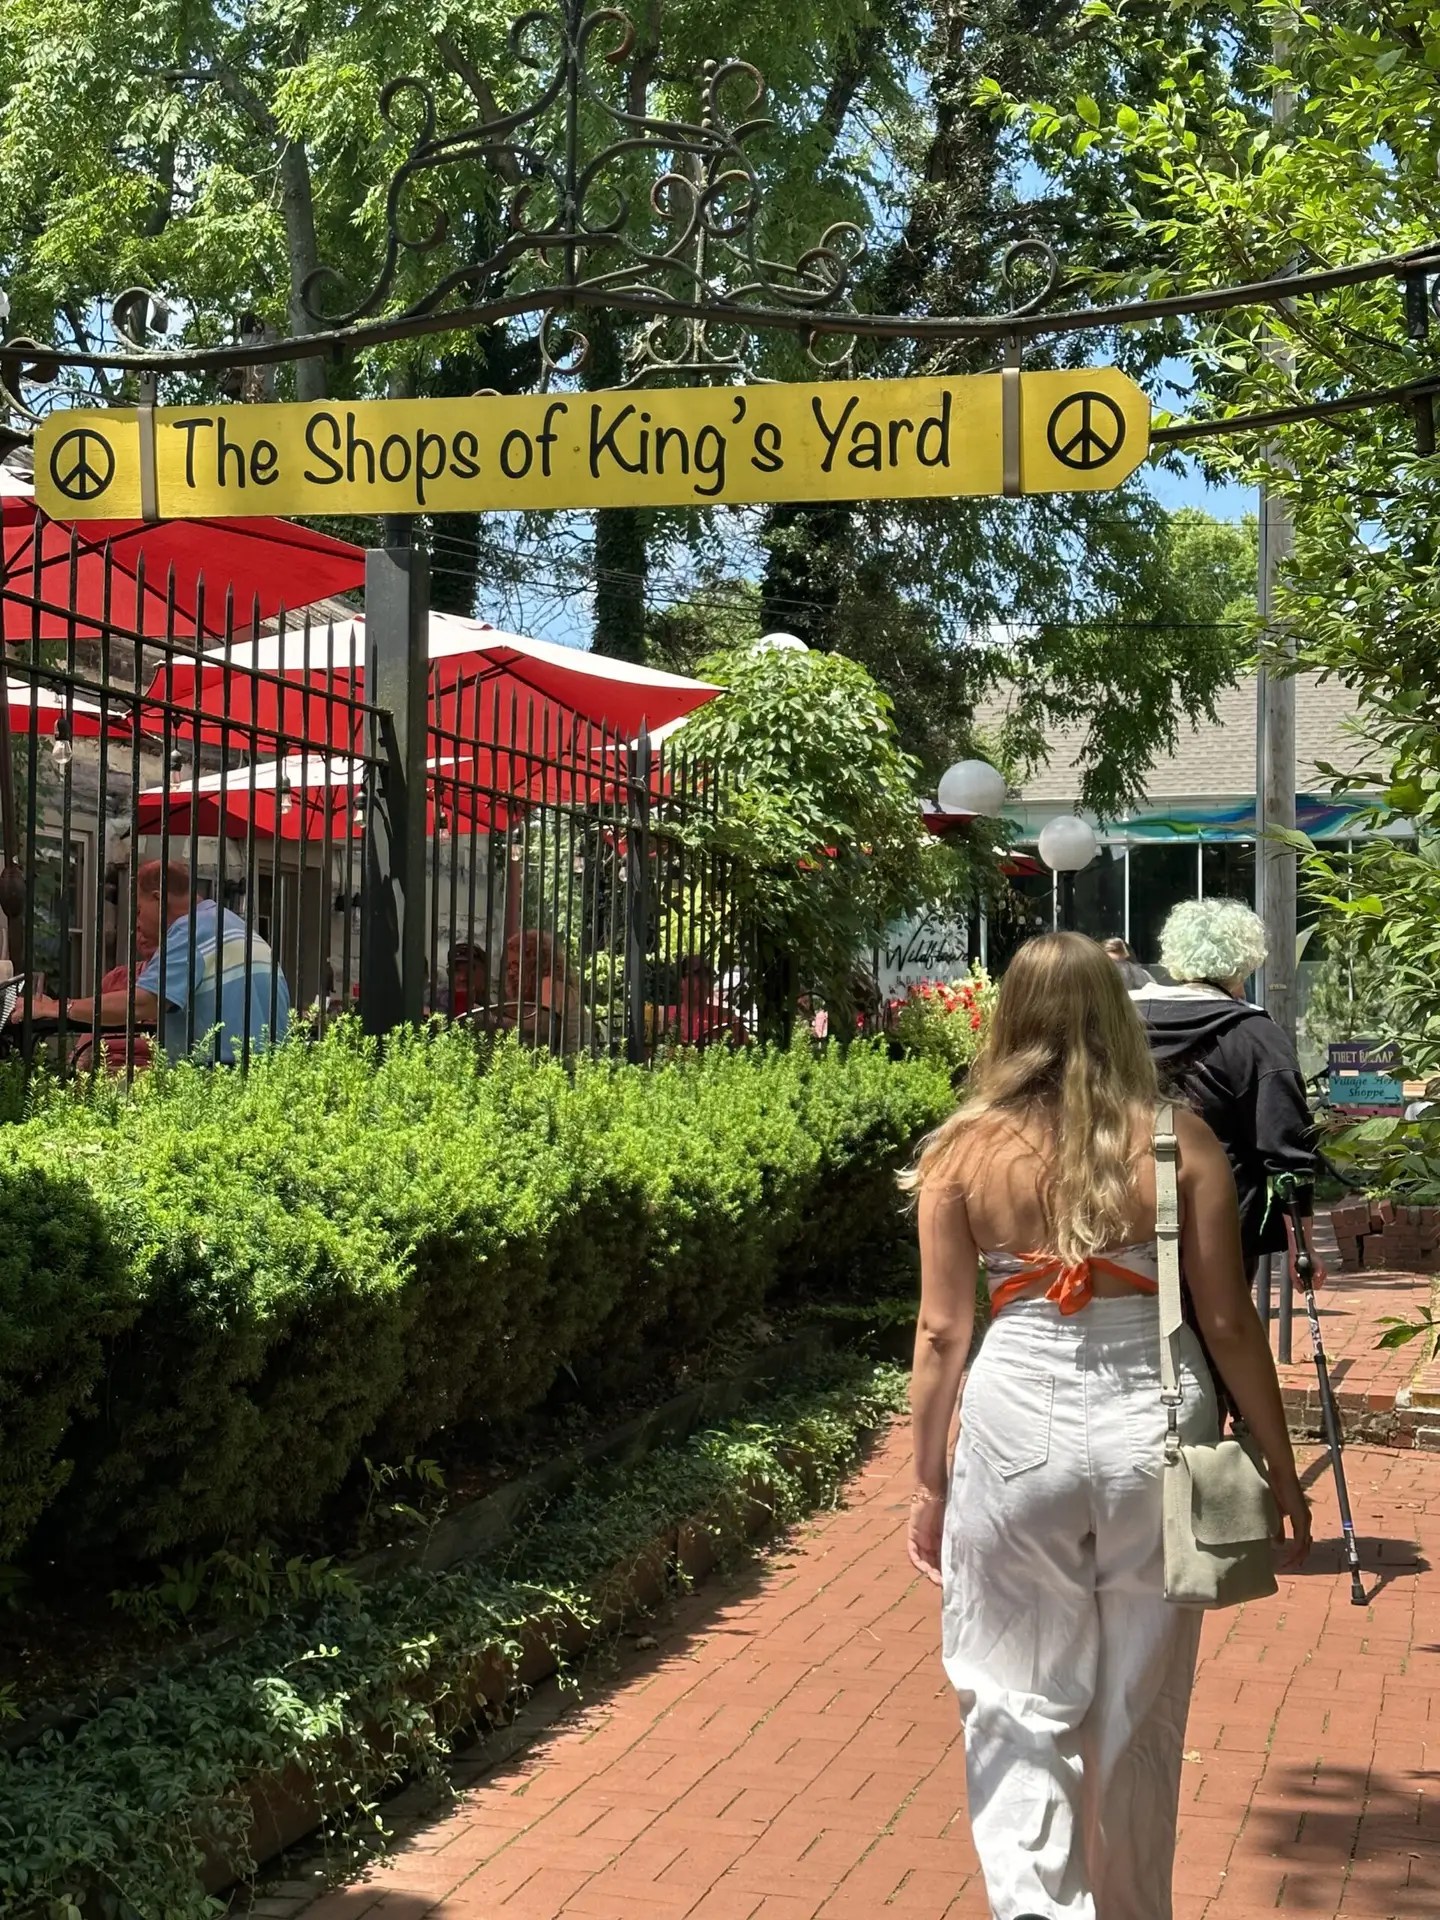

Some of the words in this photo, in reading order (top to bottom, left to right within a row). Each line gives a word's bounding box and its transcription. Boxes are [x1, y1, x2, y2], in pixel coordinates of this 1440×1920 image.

[172, 416, 280, 489] The
[303, 411, 482, 506] Shops
[499, 401, 569, 480] of
[589, 395, 785, 497] King's
[811, 390, 953, 474] Yard
[886, 911, 969, 972] Wildflowe
[1331, 1051, 1357, 1063] TIBET
[1332, 1076, 1367, 1087] Village
[1349, 1087, 1385, 1099] Shoppe
